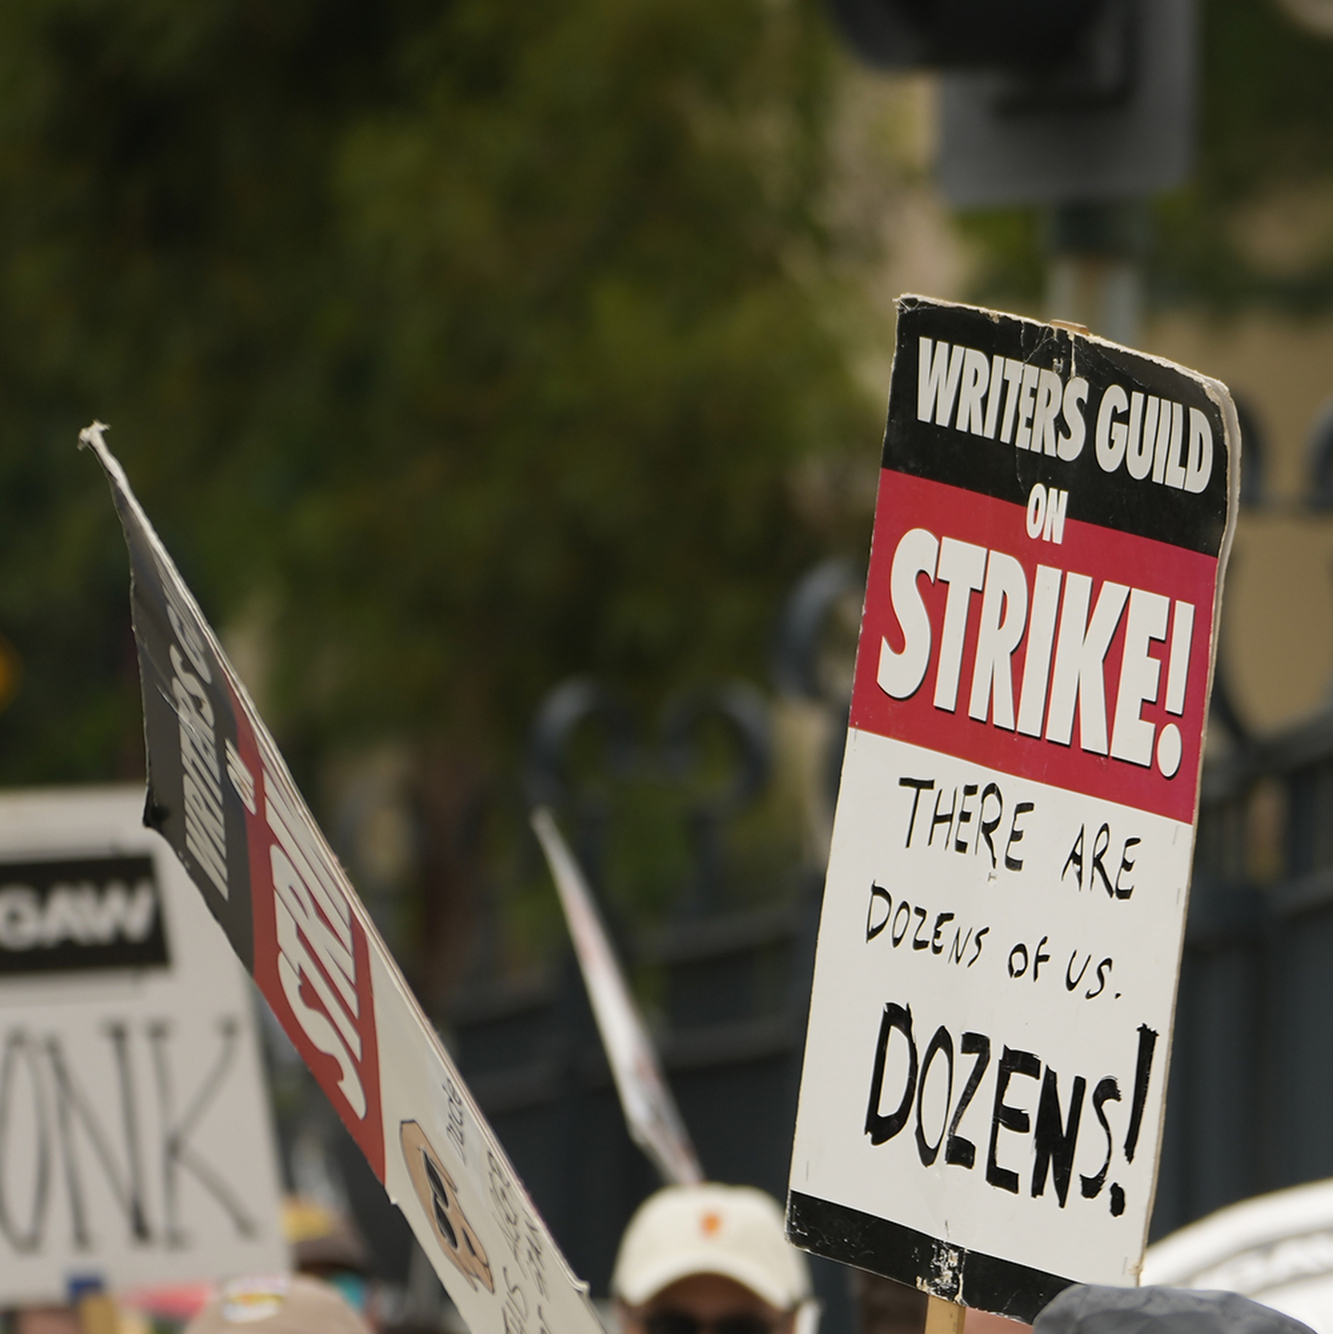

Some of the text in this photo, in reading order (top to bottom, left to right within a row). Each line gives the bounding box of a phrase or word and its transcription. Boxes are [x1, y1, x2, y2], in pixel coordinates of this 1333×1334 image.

[916, 337, 1214, 494] WRITERS GUILD
[1026, 482, 1069, 545] ON
[876, 527, 1196, 778] STRIKE!
[170, 644, 229, 900] WRITERS
[224, 737, 257, 816] ON
[899, 777, 1142, 900] THERE ARE
[865, 880, 1122, 1000] DOZENS OF US.
[864, 1001, 1161, 1217] DOZENS!
